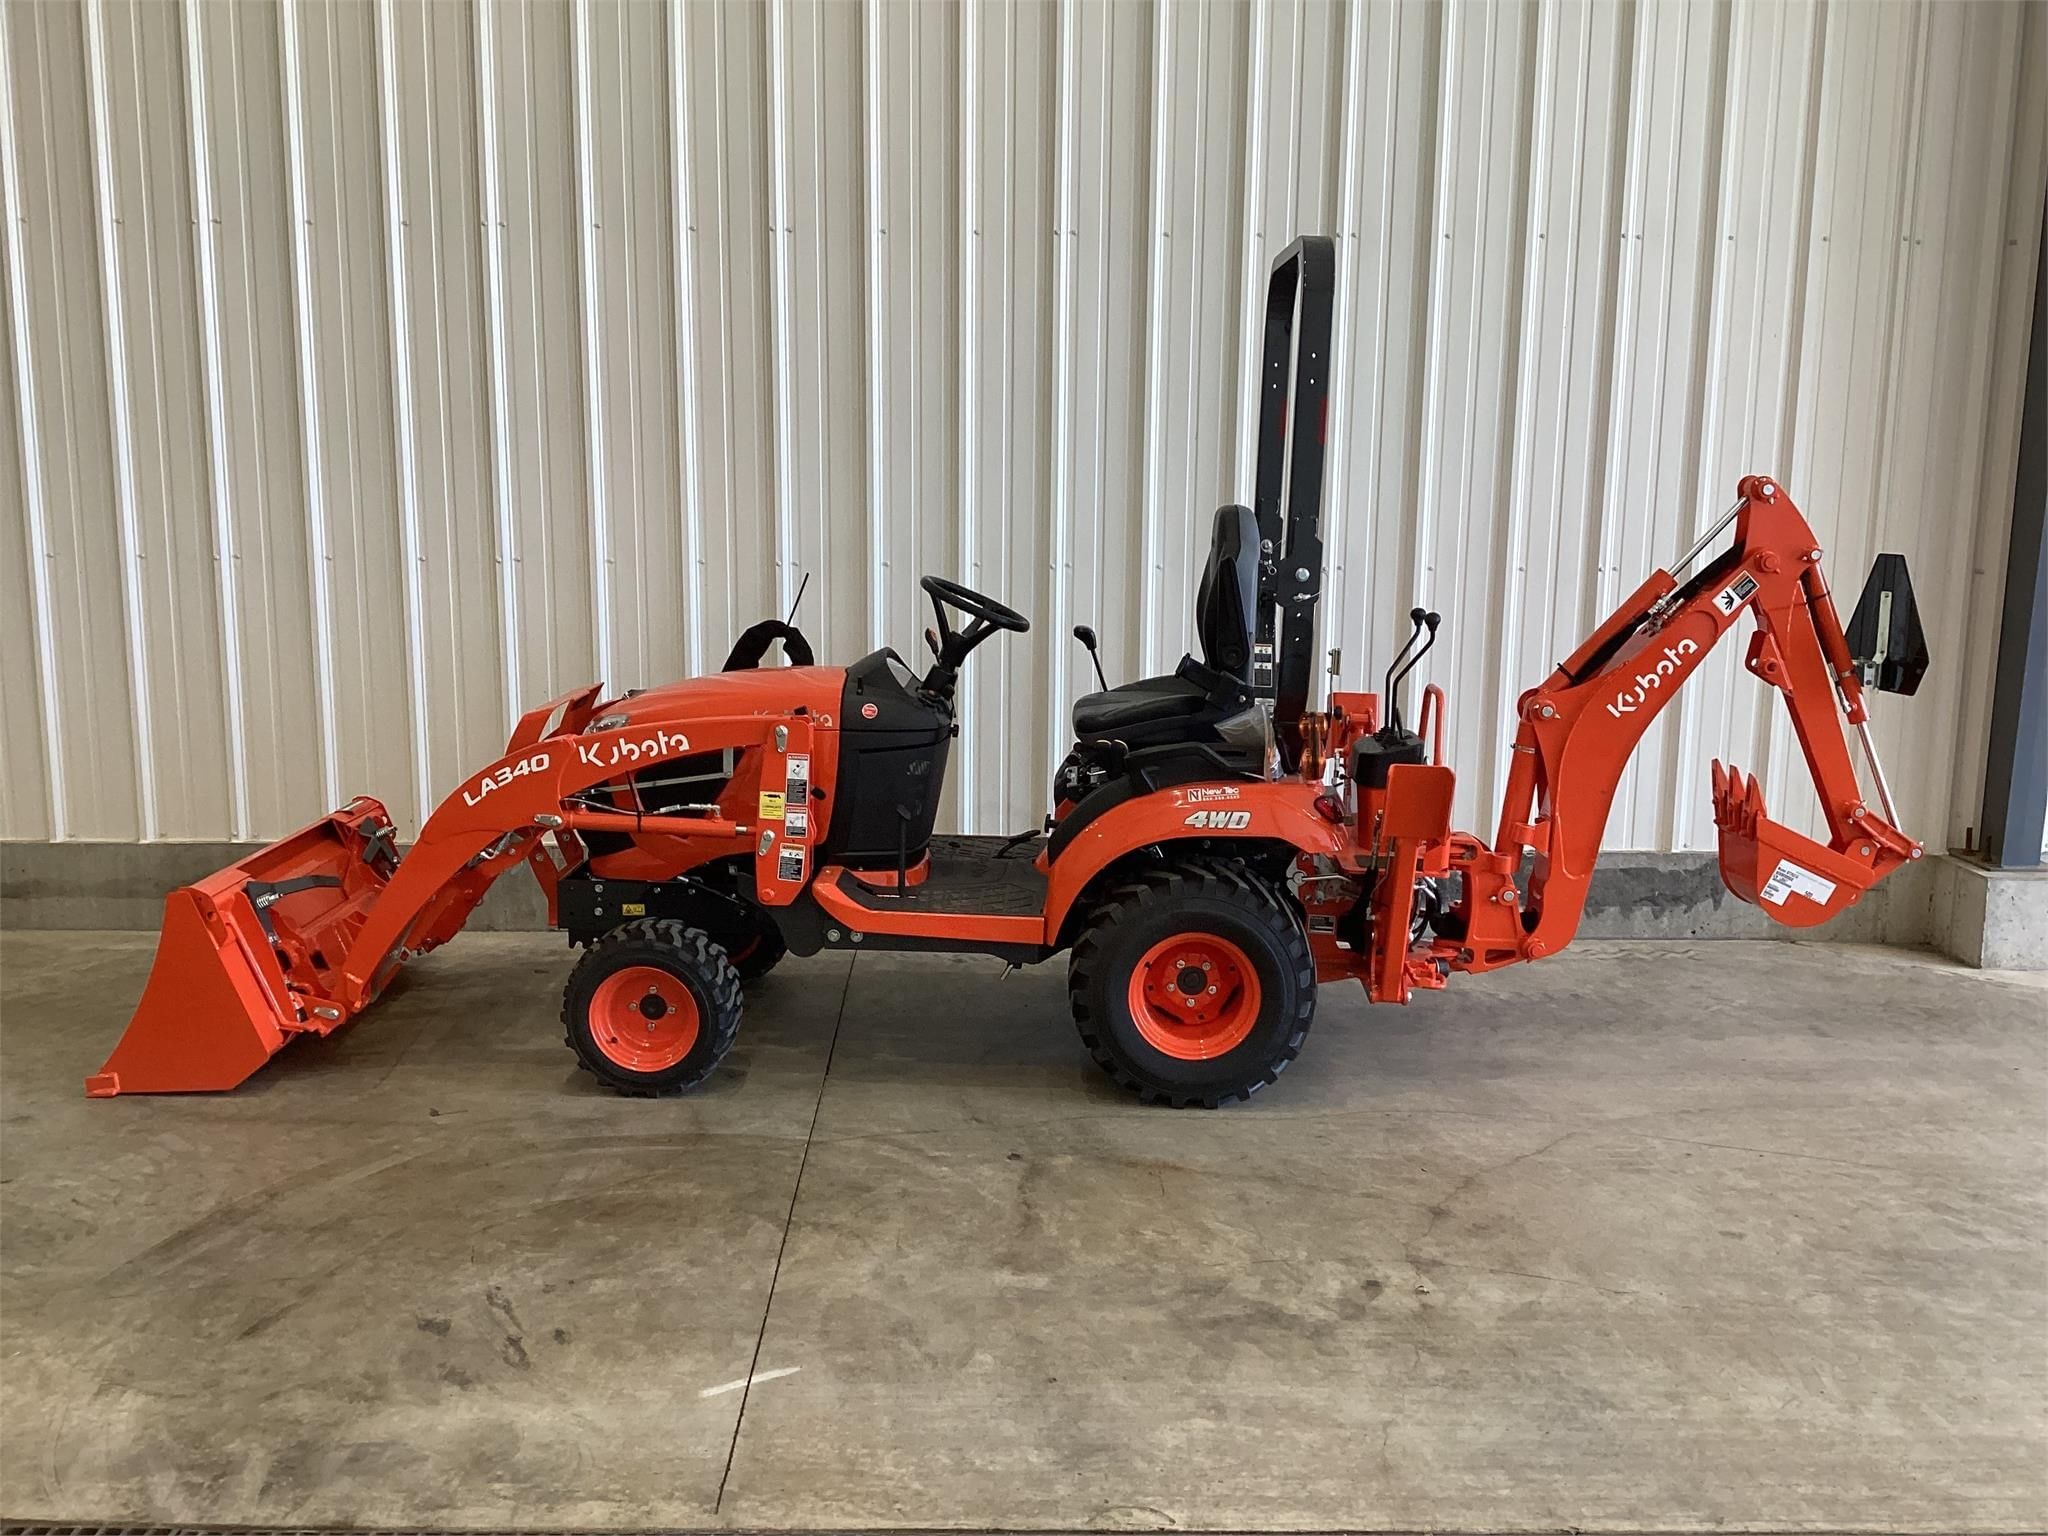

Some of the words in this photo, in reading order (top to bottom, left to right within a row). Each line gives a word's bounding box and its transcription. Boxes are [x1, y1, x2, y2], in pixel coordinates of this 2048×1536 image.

[1606, 638, 1699, 718] Kubota
[578, 730, 690, 767] Kubota
[462, 753, 550, 807] LA340
[1184, 810, 1252, 829] 4WD
